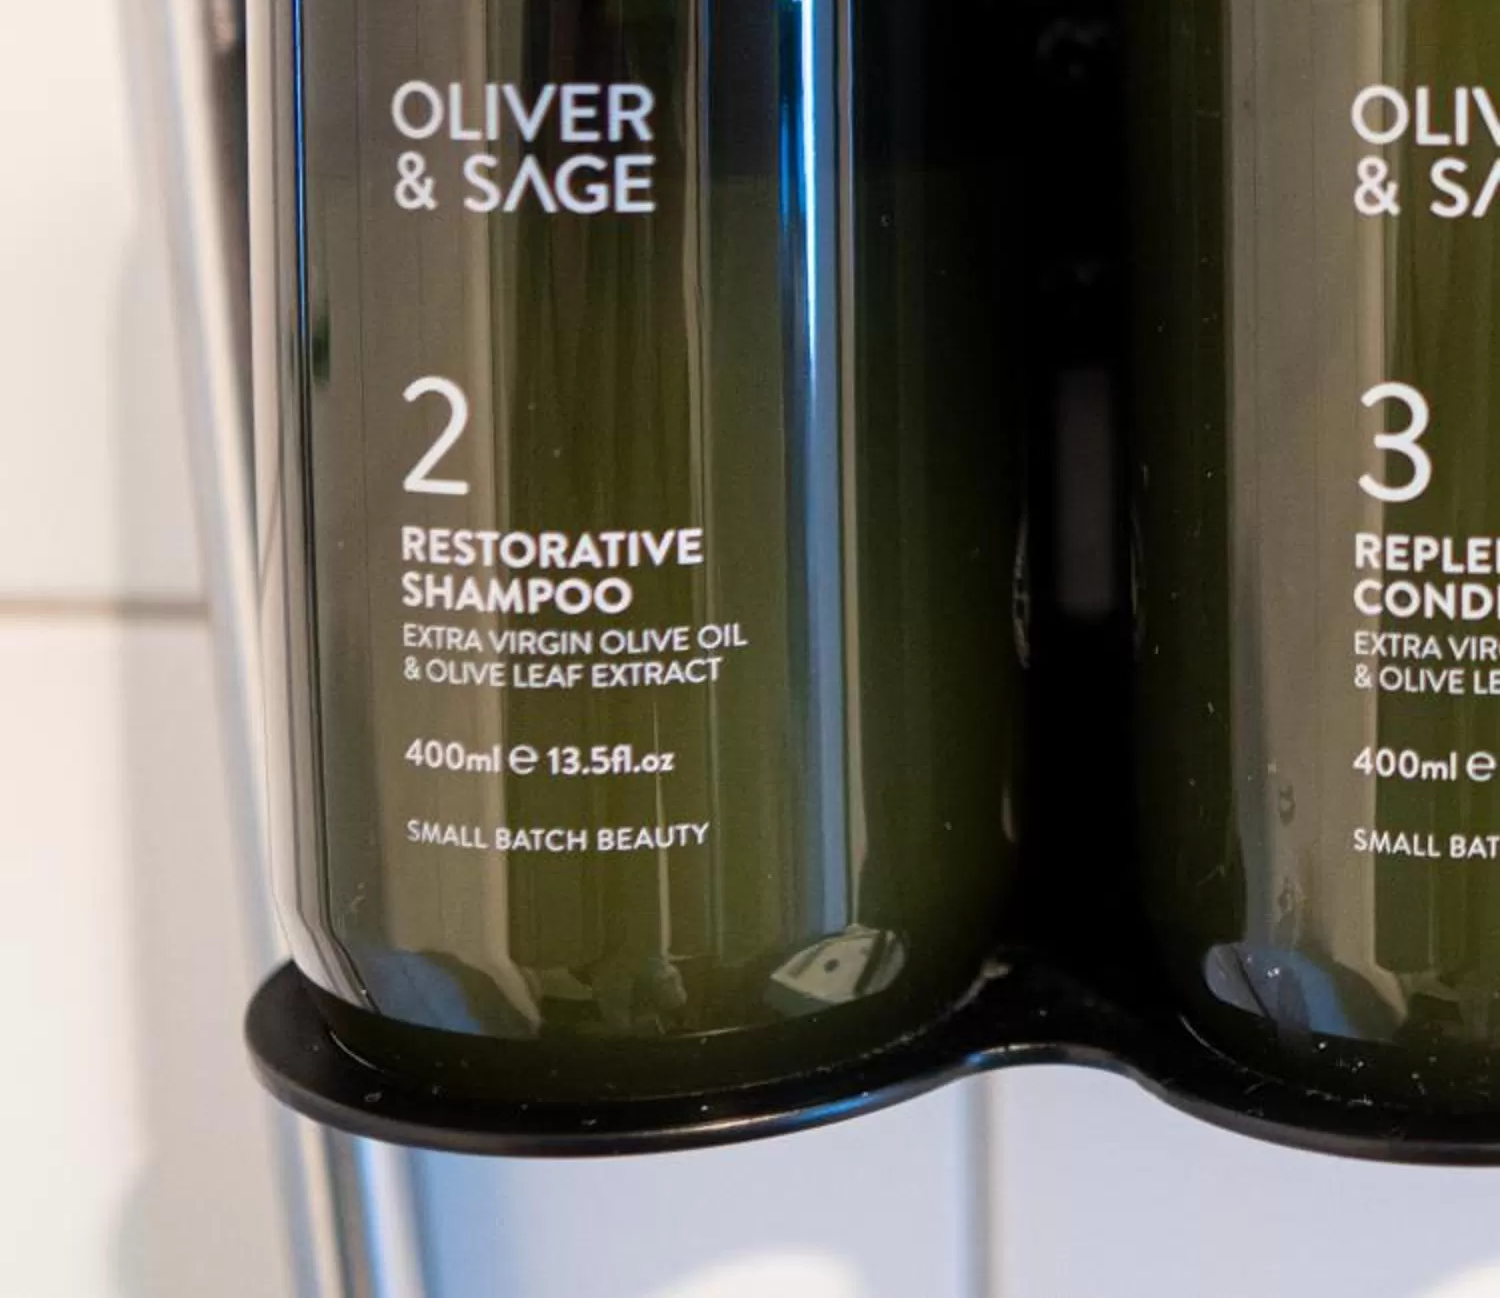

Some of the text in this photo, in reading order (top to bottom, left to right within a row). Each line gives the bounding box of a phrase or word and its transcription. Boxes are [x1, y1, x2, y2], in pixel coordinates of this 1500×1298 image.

[391, 80, 655, 142] OLIVER
[394, 151, 438, 211] &
[1353, 155, 1400, 215] &
[402, 376, 469, 495] 2
[1358, 381, 1432, 502] 3
[401, 526, 704, 569] RESTORATIVE
[401, 571, 633, 614] SHAMPOO
[403, 623, 748, 655] EXTRA VIRGIN OLIVE OIL
[1354, 631, 1442, 660] EXTRA
[404, 656, 723, 688] & OLIVE LEAF EXTRACT
[1354, 664, 1373, 689] &
[1379, 666, 1464, 694] OLIVE
[405, 739, 501, 774] 400ml
[547, 745, 675, 776] 13.5fl.oz
[1352, 747, 1457, 781] 400ml
[406, 820, 710, 852] SMALL BATCH BEAUTY
[1353, 828, 1440, 857] SMALL
